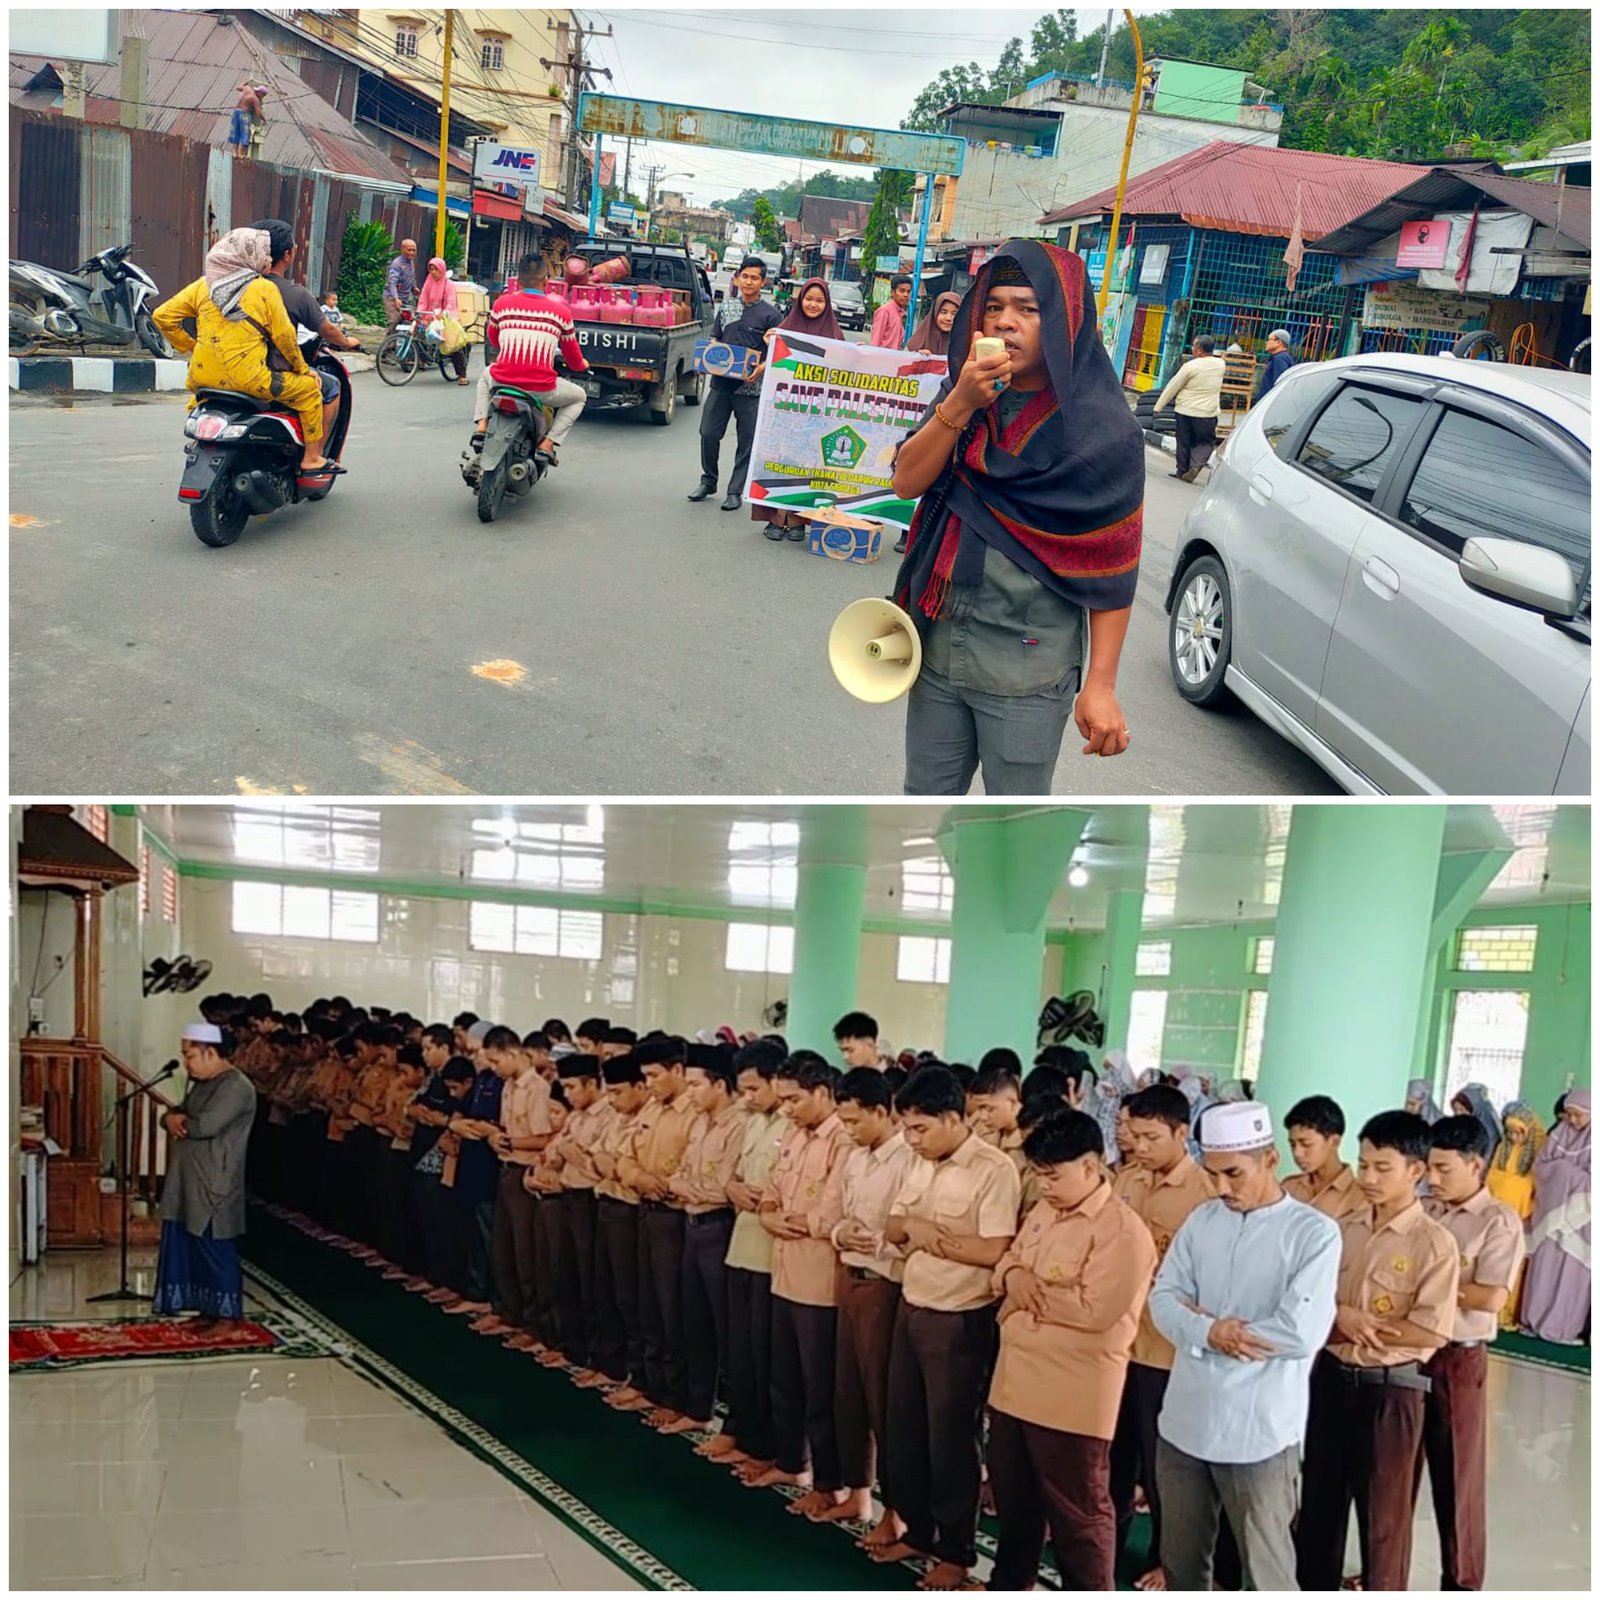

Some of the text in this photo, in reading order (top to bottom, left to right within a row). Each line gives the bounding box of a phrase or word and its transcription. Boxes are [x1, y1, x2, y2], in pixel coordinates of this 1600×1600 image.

[491, 149, 536, 170] JNE
[579, 332, 637, 350] BISHI
[794, 363, 920, 398] AKSI SOLIDARITAS
[774, 382, 824, 414] SAVE
[764, 460, 809, 479] PERGURUAN
[809, 480, 830, 492] KOTA
